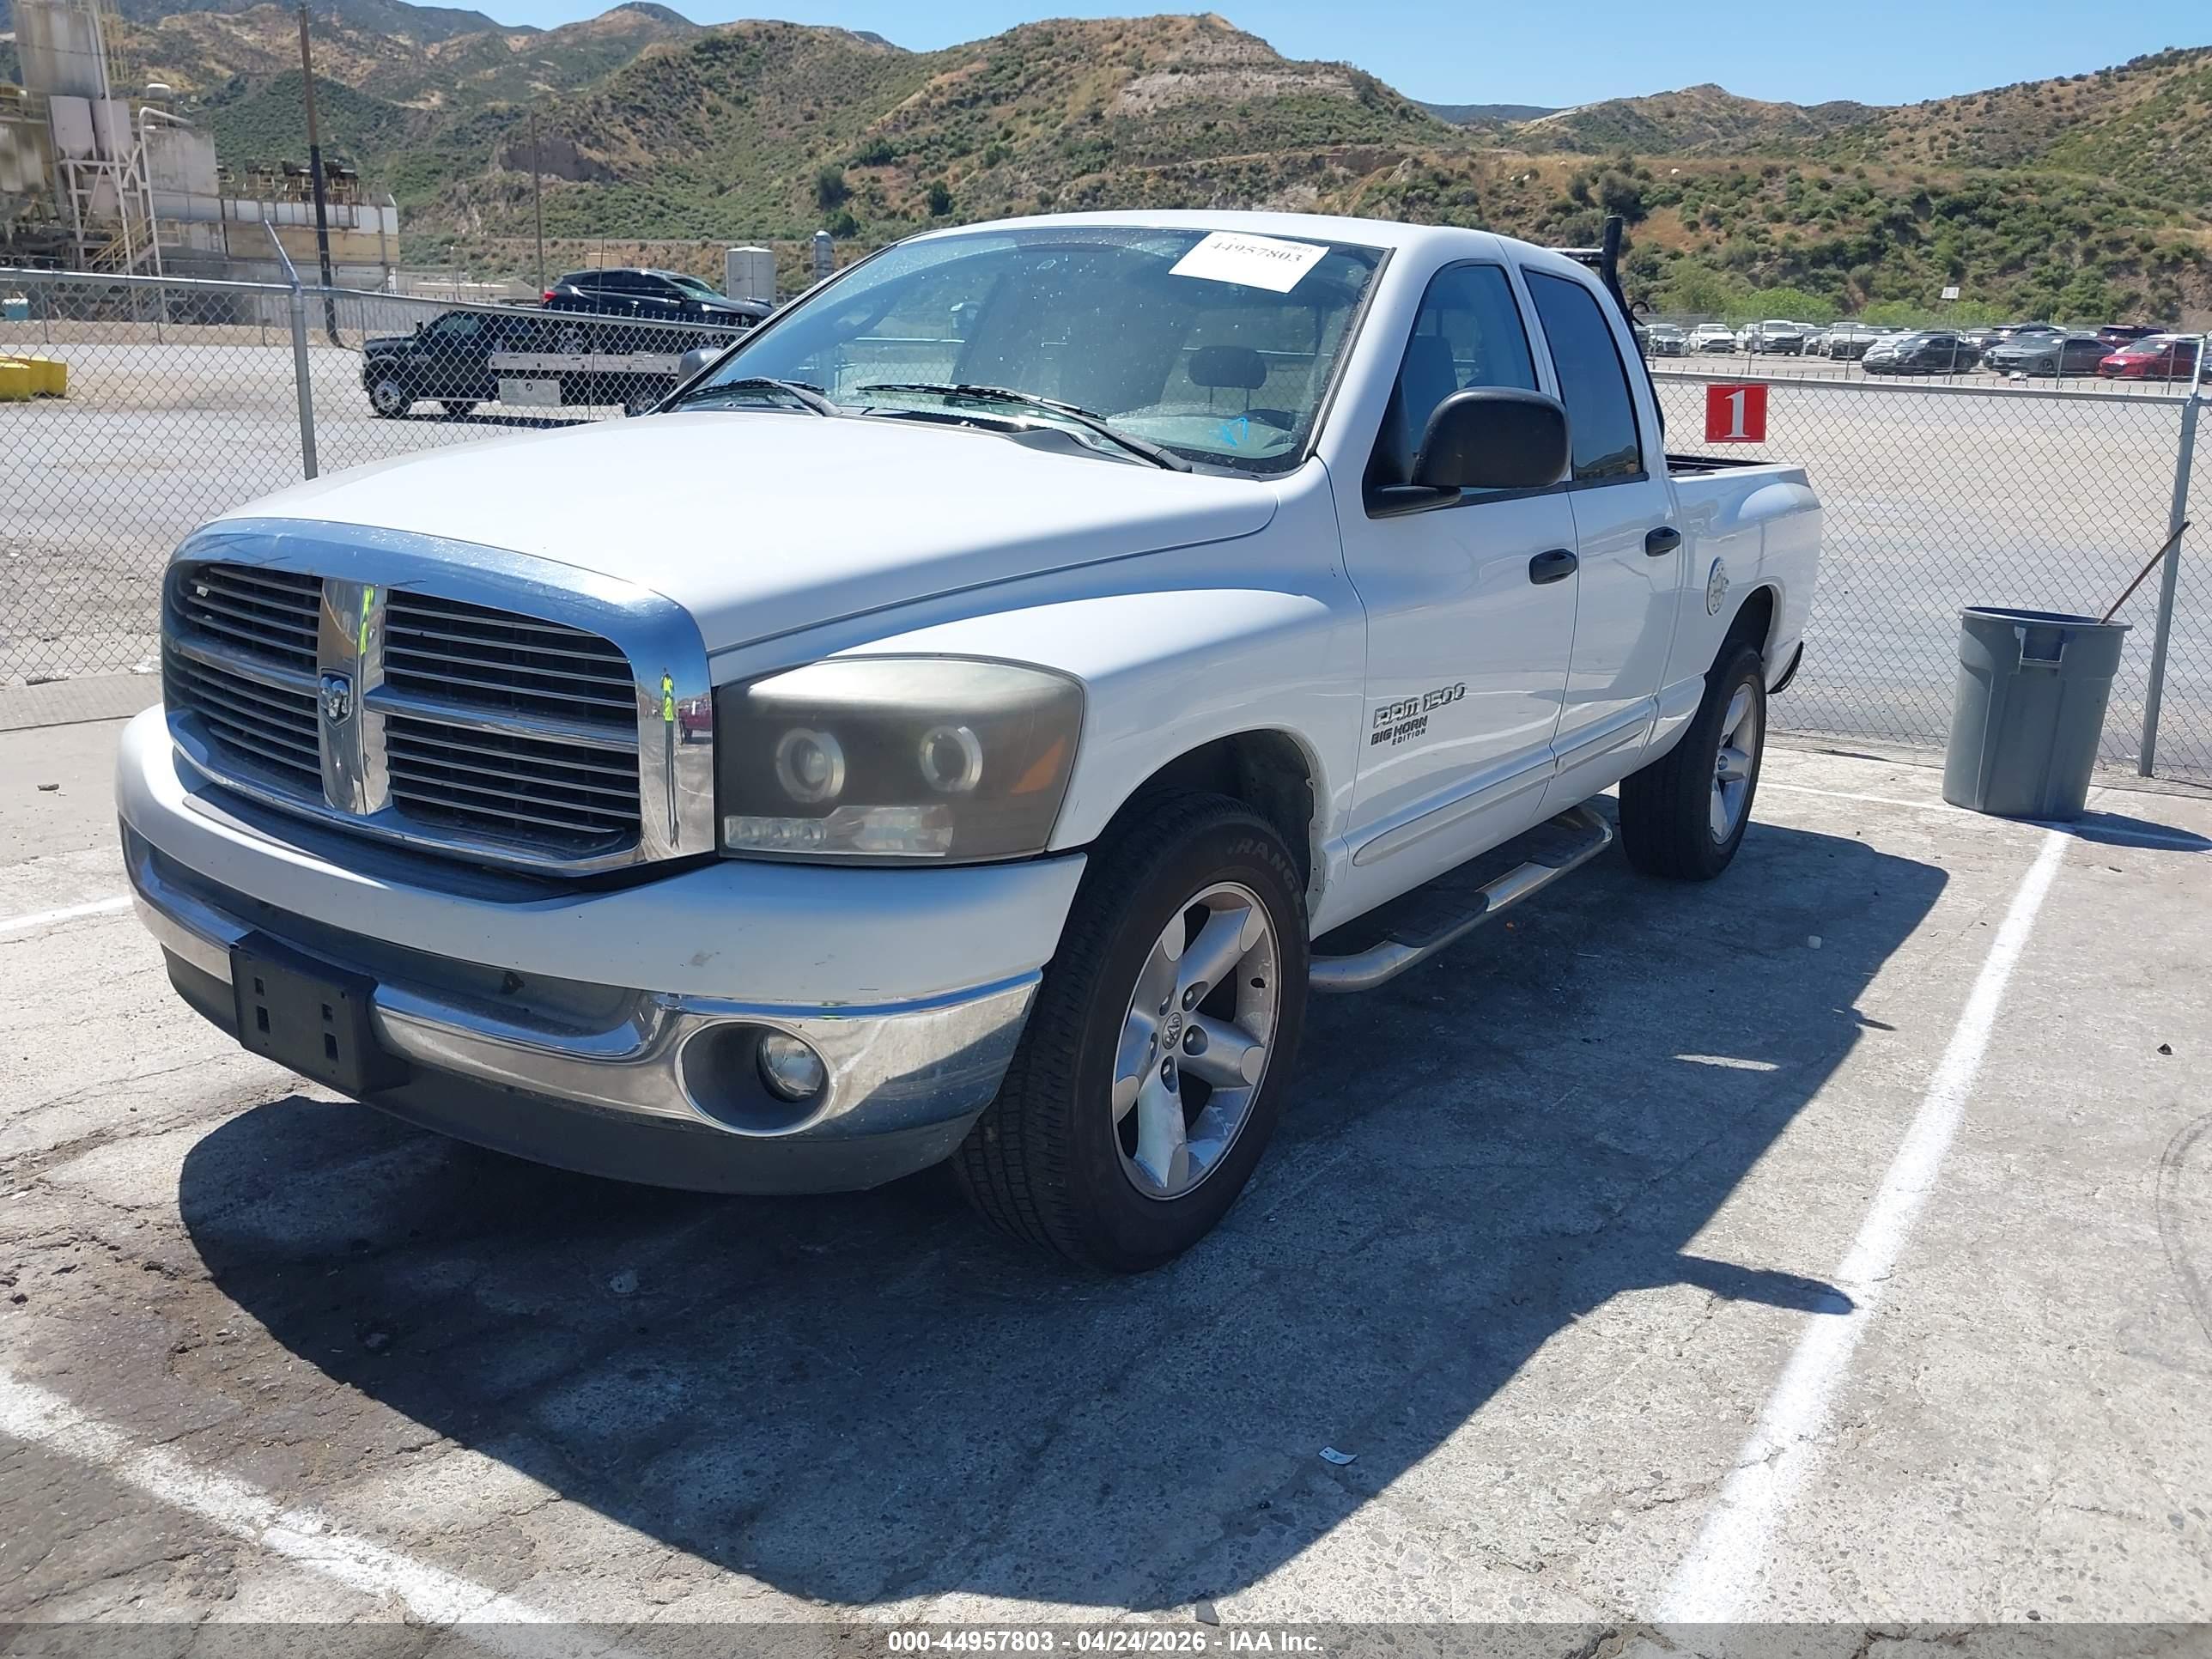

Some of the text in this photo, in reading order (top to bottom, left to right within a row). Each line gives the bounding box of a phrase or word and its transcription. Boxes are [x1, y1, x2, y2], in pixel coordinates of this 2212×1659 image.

[1724, 389, 1751, 438] 1
[1373, 682, 1468, 728] RAM 1500
[1370, 715, 1428, 745] BIG HORN
[1391, 728, 1426, 745] EDITION
